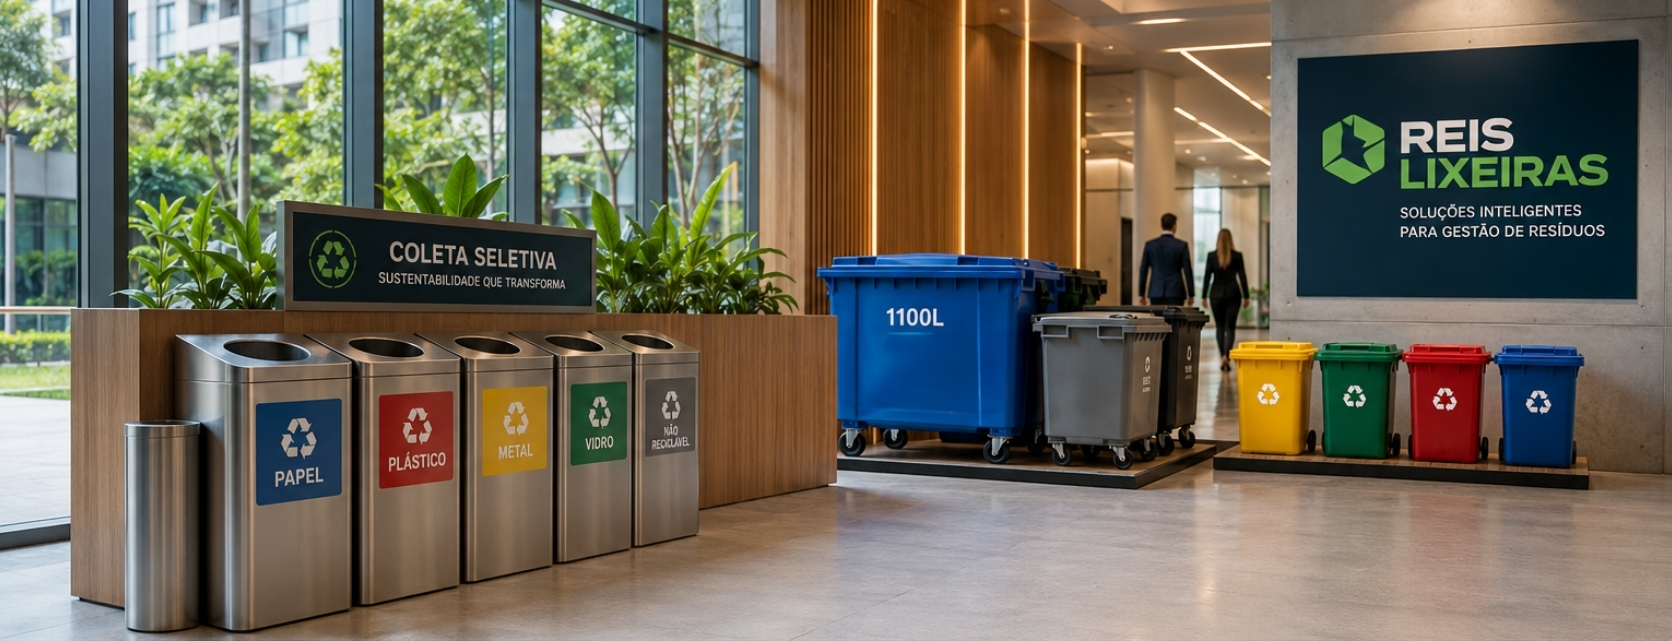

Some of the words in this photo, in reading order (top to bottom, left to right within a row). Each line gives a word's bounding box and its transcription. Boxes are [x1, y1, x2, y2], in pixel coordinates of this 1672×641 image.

[1400, 117, 1514, 153] REIS
[1400, 154, 1609, 189] LIXEIRAS
[1400, 204, 1475, 220] SOLUÇÕES
[1480, 204, 1582, 218] INTELIGENTES
[1400, 225, 1438, 238] PARA
[1442, 222, 1500, 238] GESTÃO
[1505, 224, 1524, 237] DE
[1529, 222, 1606, 238] RESÍDUOS
[389, 241, 469, 266] COLETA
[474, 246, 557, 270] SELETIVA
[378, 271, 481, 287] SUSTENTABILIDADE
[483, 276, 503, 288] QUE
[505, 277, 566, 289] TRANSFORMA
[886, 308, 945, 327] 1100L
[498, 443, 534, 460] METAL
[585, 436, 614, 450] VIDRO
[388, 450, 447, 473] PLÁSTICO
[274, 466, 325, 488] PAPEL
